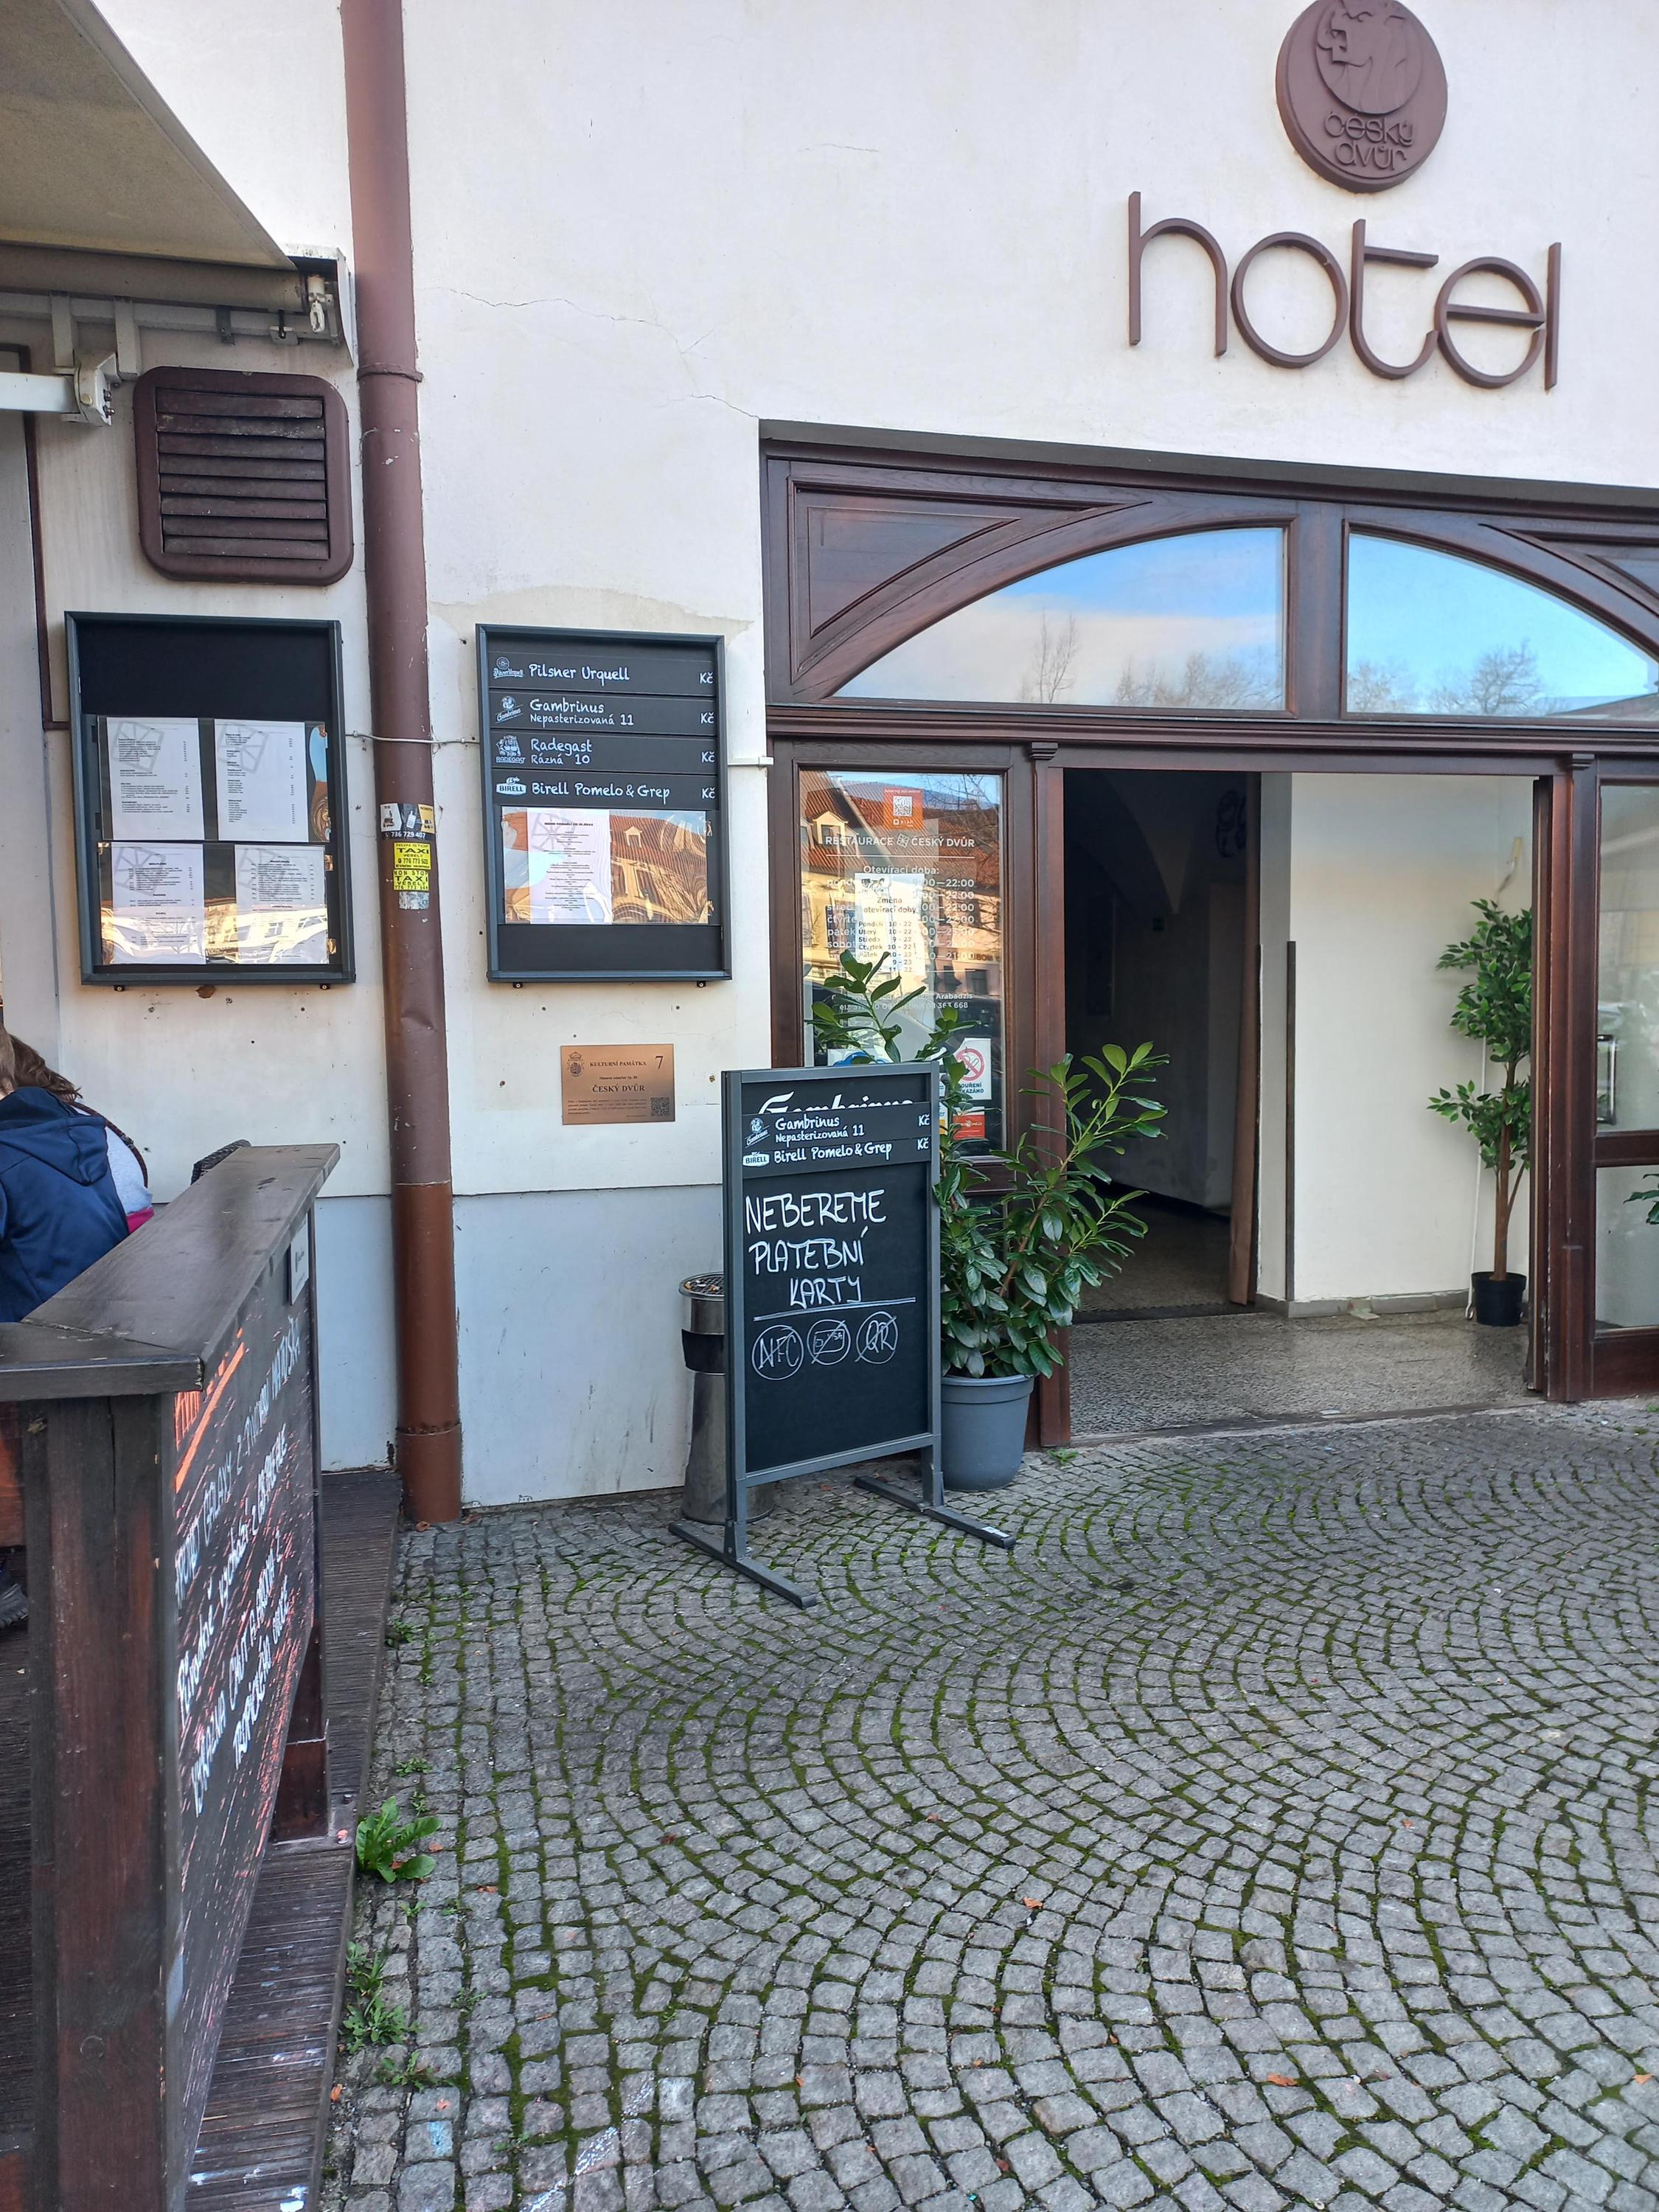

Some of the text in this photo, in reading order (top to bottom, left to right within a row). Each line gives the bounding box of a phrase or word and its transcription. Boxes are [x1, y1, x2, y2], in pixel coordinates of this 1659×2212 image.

[1335, 140, 1407, 171] dvůr
[1129, 191, 1562, 390] hotel
[529, 664, 630, 686] Pilsner Urquell
[700, 672, 713, 684] Kč
[530, 698, 605, 714] Gambrinus
[530, 714, 634, 728] Nepasterizovaná 11
[700, 712, 714, 724] Kč
[531, 737, 592, 756] Radegast
[532, 754, 590, 765] Rázná 10
[701, 751, 715, 762] Kč
[532, 783, 670, 804] Birell Pomelo & Grep
[702, 787, 715, 799] Kč
[825, 835, 975, 847] RESTAURACE ČESKÝ DVŮR
[911, 866, 939, 874] doba:
[655, 1055, 664, 1069] 7
[592, 1084, 645, 1093] ČESKÝ DVŮR
[775, 1113, 840, 1131] Gambrinus
[919, 1114, 931, 1127] Kč
[775, 1124, 865, 1147] Nepasterizovaná 11
[917, 1138, 929, 1150] Kč
[774, 1141, 892, 1164] Birell Pomelo & Grep
[745, 1189, 886, 1234] NEBEREME
[748, 1225, 868, 1275] PLATEBNÍ
[790, 1276, 862, 1309] KARTY
[758, 1334, 800, 1369] NFC
[866, 1320, 895, 1353] QR
